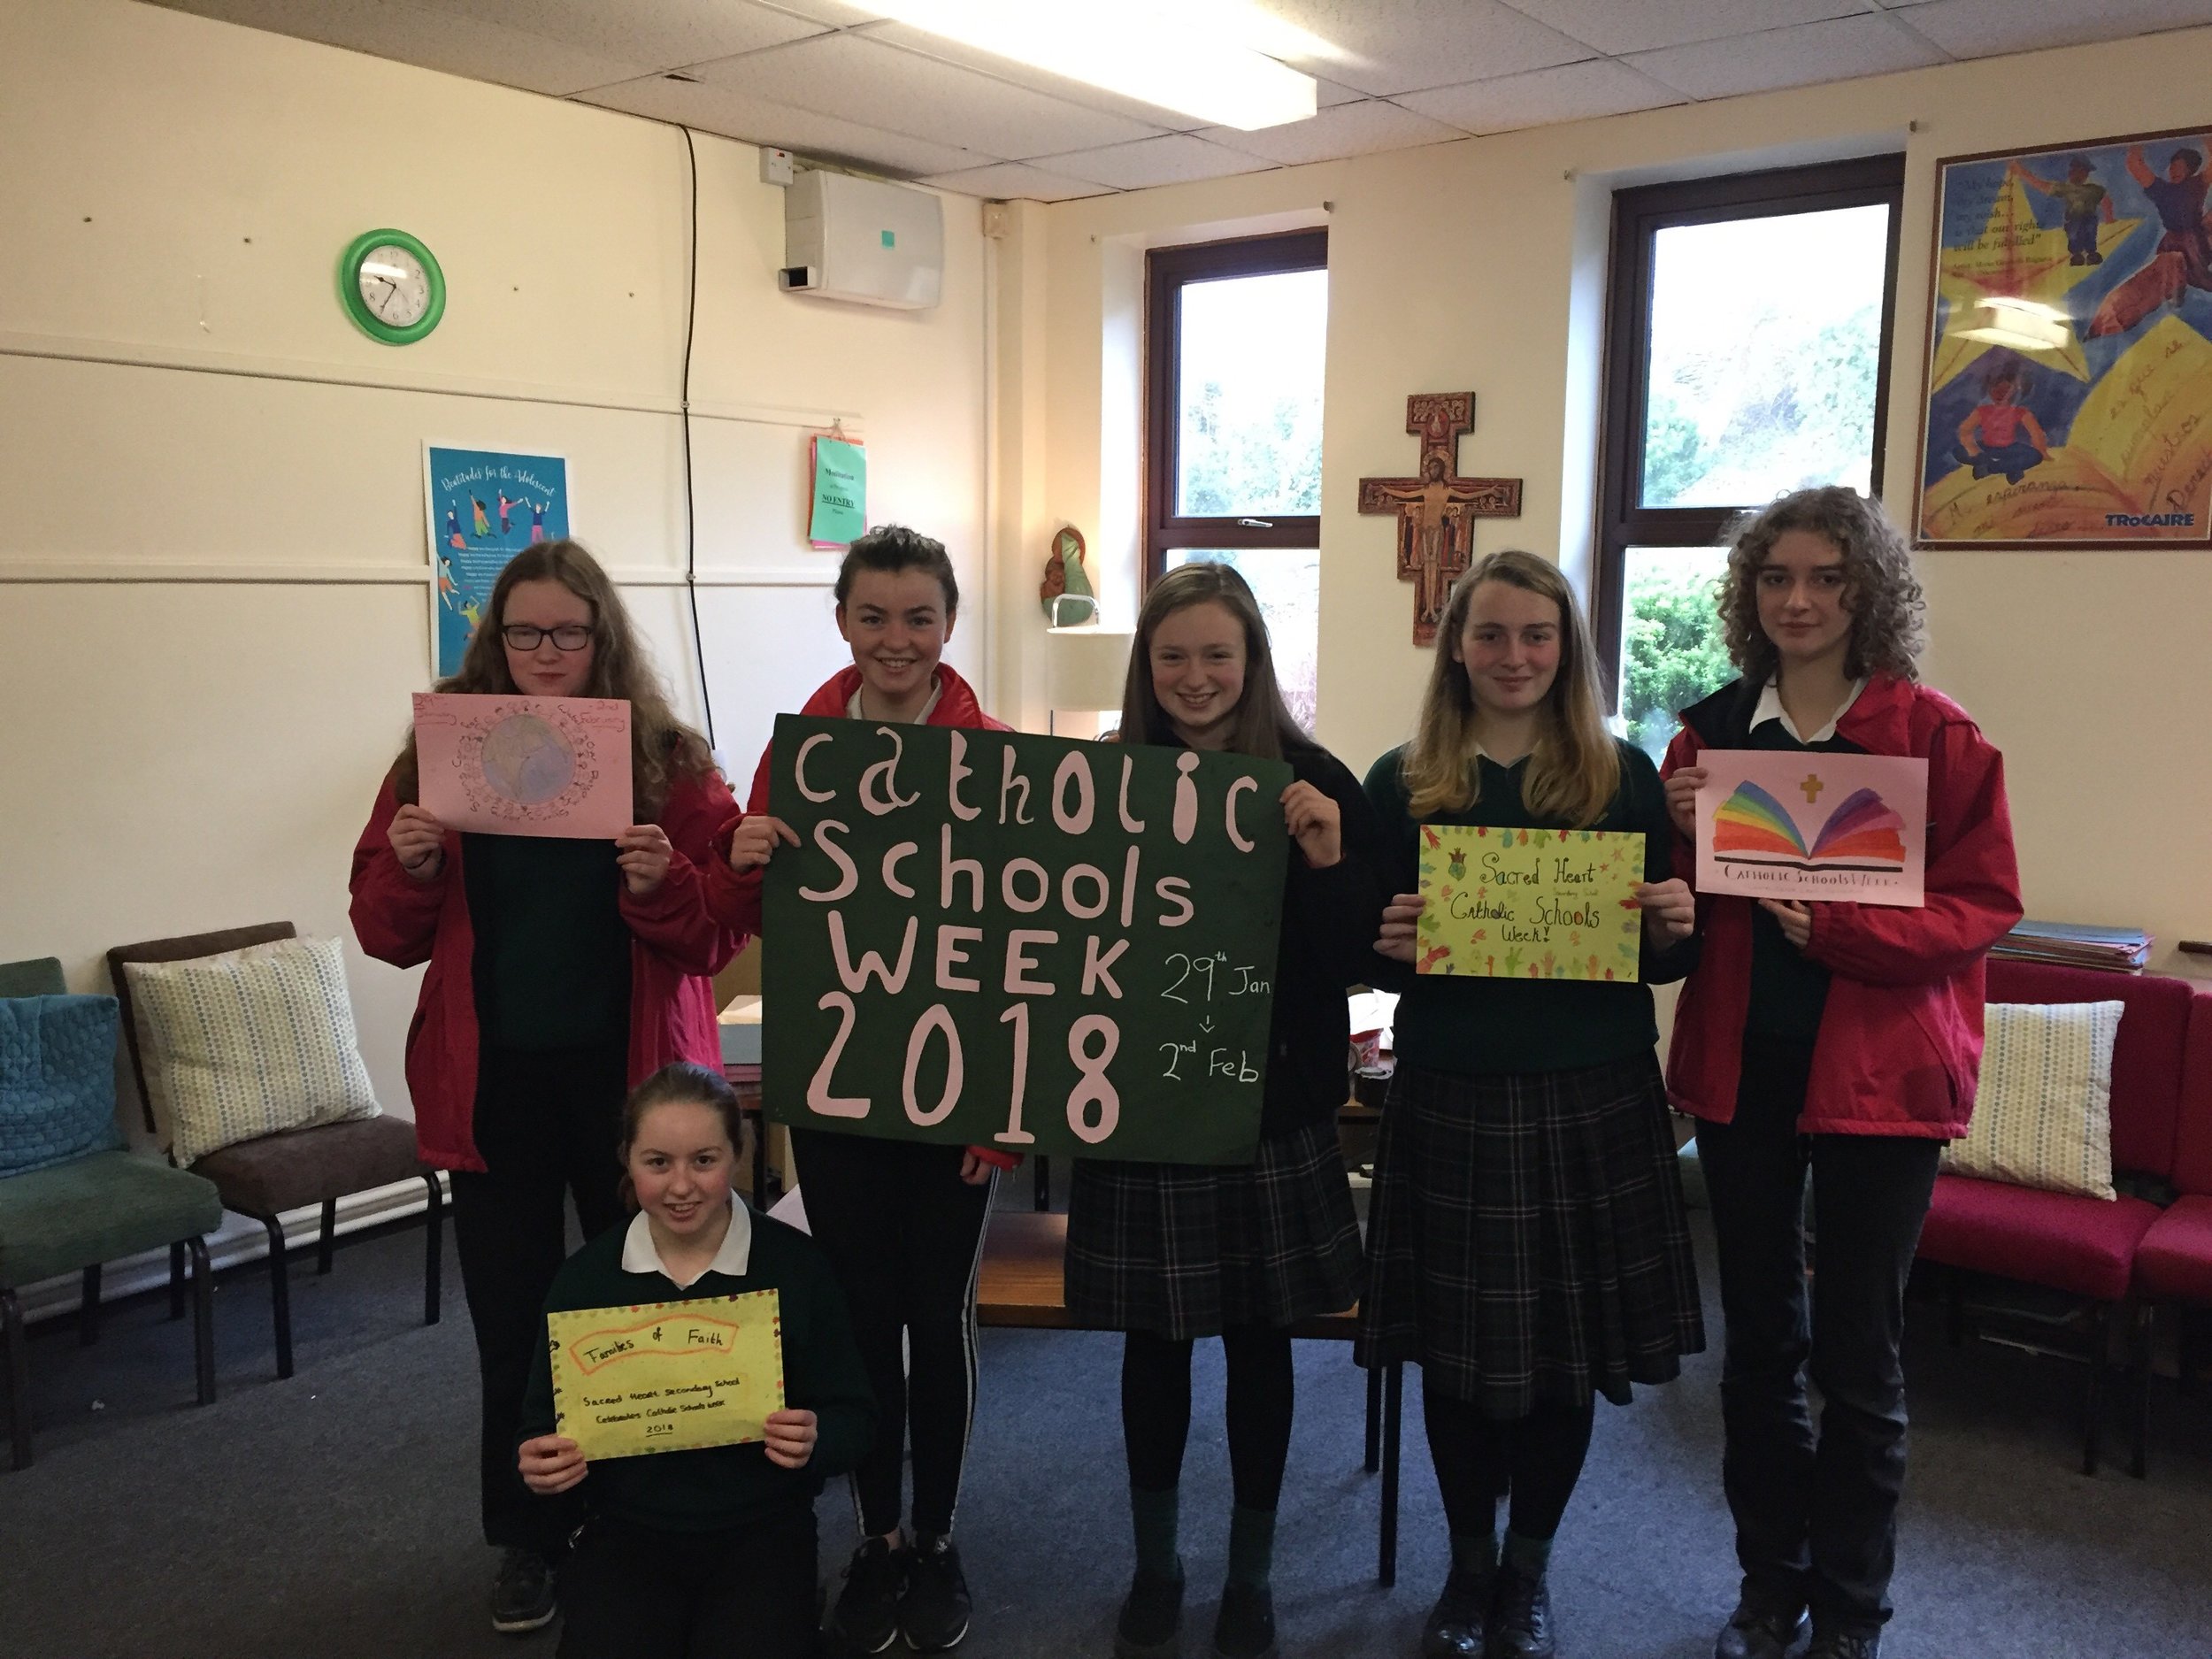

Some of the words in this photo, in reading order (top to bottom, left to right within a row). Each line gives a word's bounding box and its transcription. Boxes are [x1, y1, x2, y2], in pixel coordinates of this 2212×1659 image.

[485, 465, 496, 480] for
[500, 465, 512, 479] the
[822, 494, 833, 503] NO
[833, 496, 856, 507] ENTRY
[2105, 512, 2195, 527] TROCAIRE
[798, 818, 1194, 927] Schools
[1479, 851, 1540, 886] Sacred
[1553, 856, 1597, 884] Heart
[1450, 891, 1515, 922] Catholic
[1529, 895, 1600, 929] Schools
[1502, 924, 1550, 943] Week!
[826, 909, 1130, 999] WEEK
[1160, 950, 1227, 1003] 29th
[1228, 965, 1271, 995] Jan
[805, 989, 1121, 1144] 2018
[1159, 1040, 1196, 1081] 2nd
[1209, 1048, 1259, 1083] Feb
[583, 1338, 635, 1363] Families
[652, 1326, 663, 1342] of
[687, 1328, 723, 1347] Faith
[583, 1394, 623, 1407] Sacred
